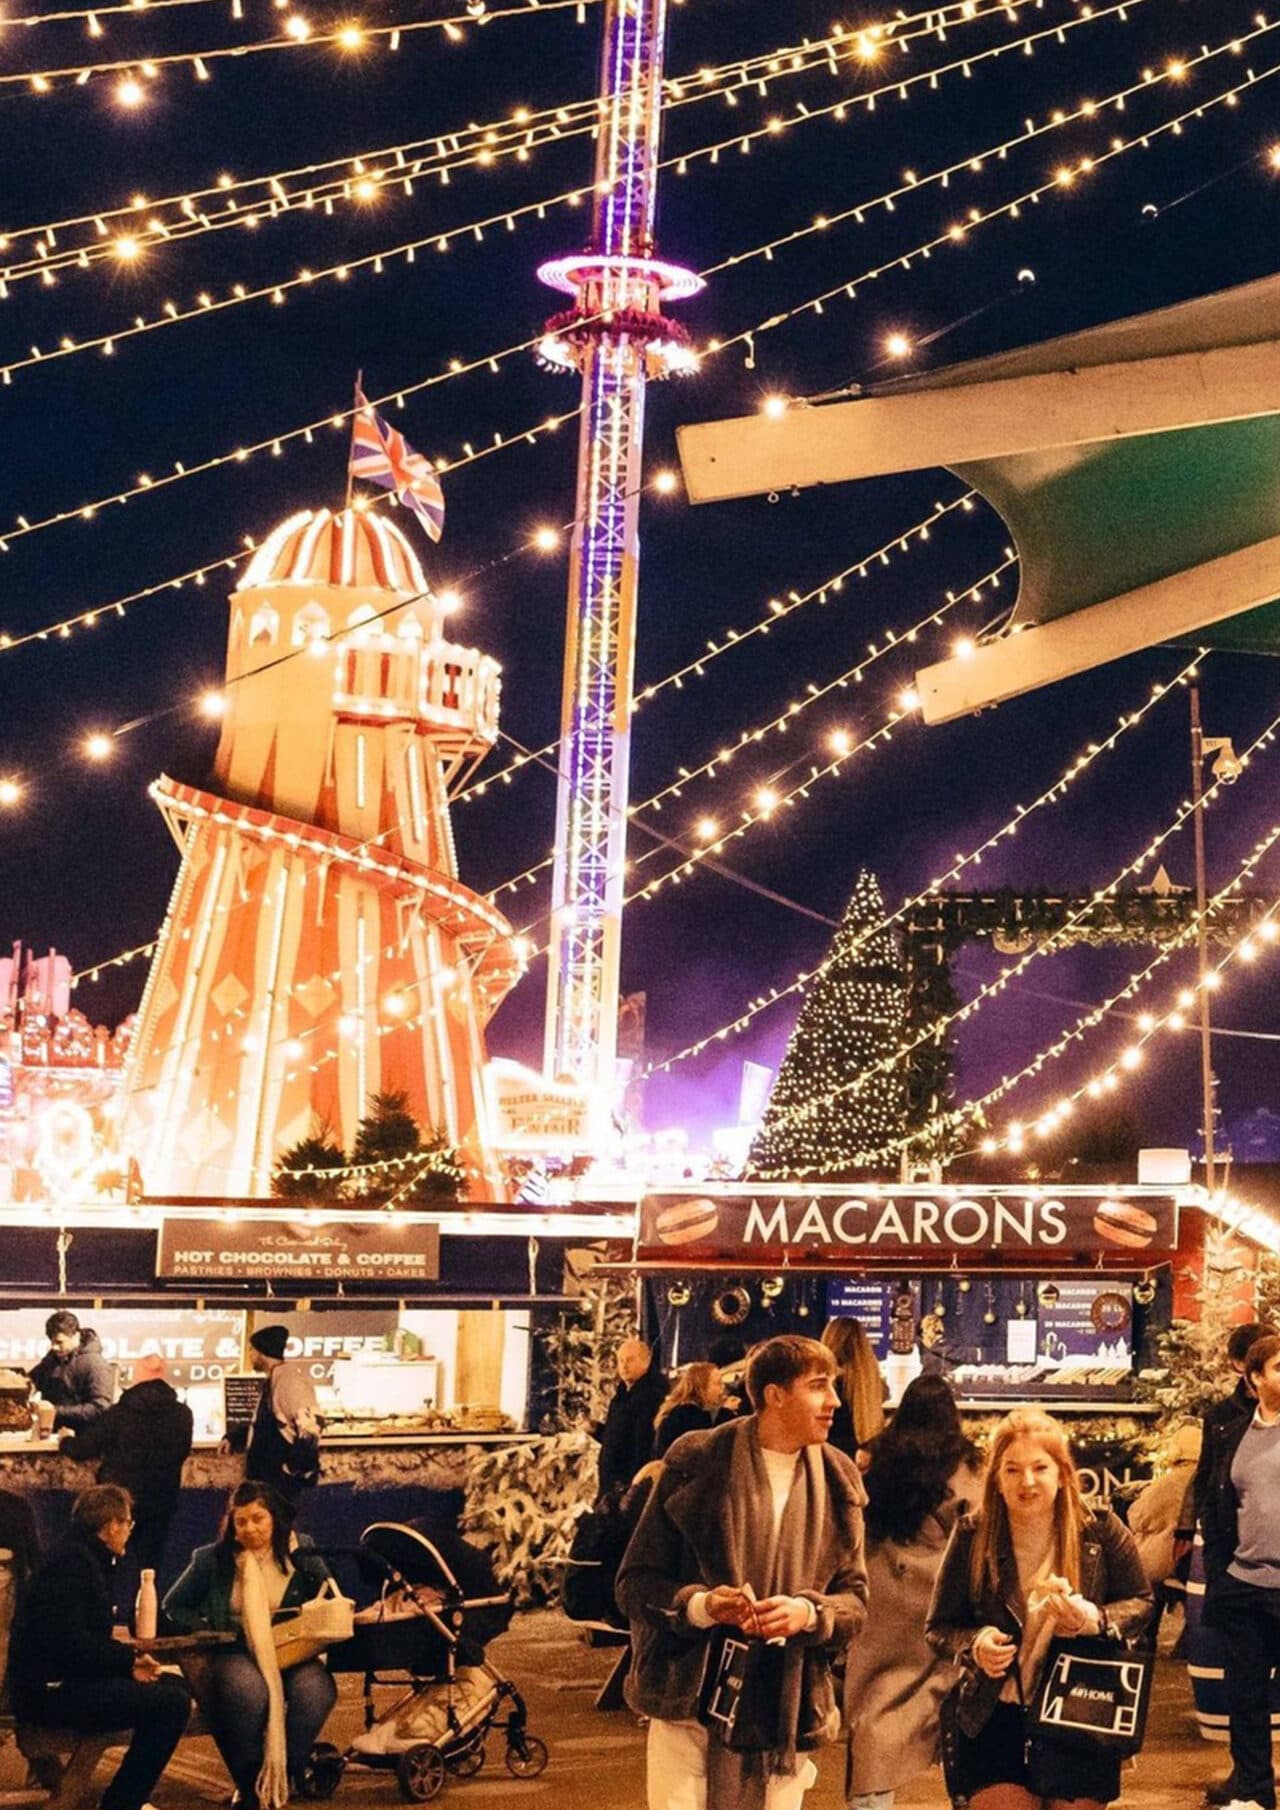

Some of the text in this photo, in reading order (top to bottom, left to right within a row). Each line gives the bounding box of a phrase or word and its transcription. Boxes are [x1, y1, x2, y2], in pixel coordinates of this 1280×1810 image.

[743, 1199, 1067, 1245] MACARONS
[174, 1251, 426, 1266] HOT CHOCOLATE & COFFEE
[174, 1266, 426, 1277] PASTRIES BROWNIES DONUTS CAKES
[282, 1336, 384, 1358] OFFEE
